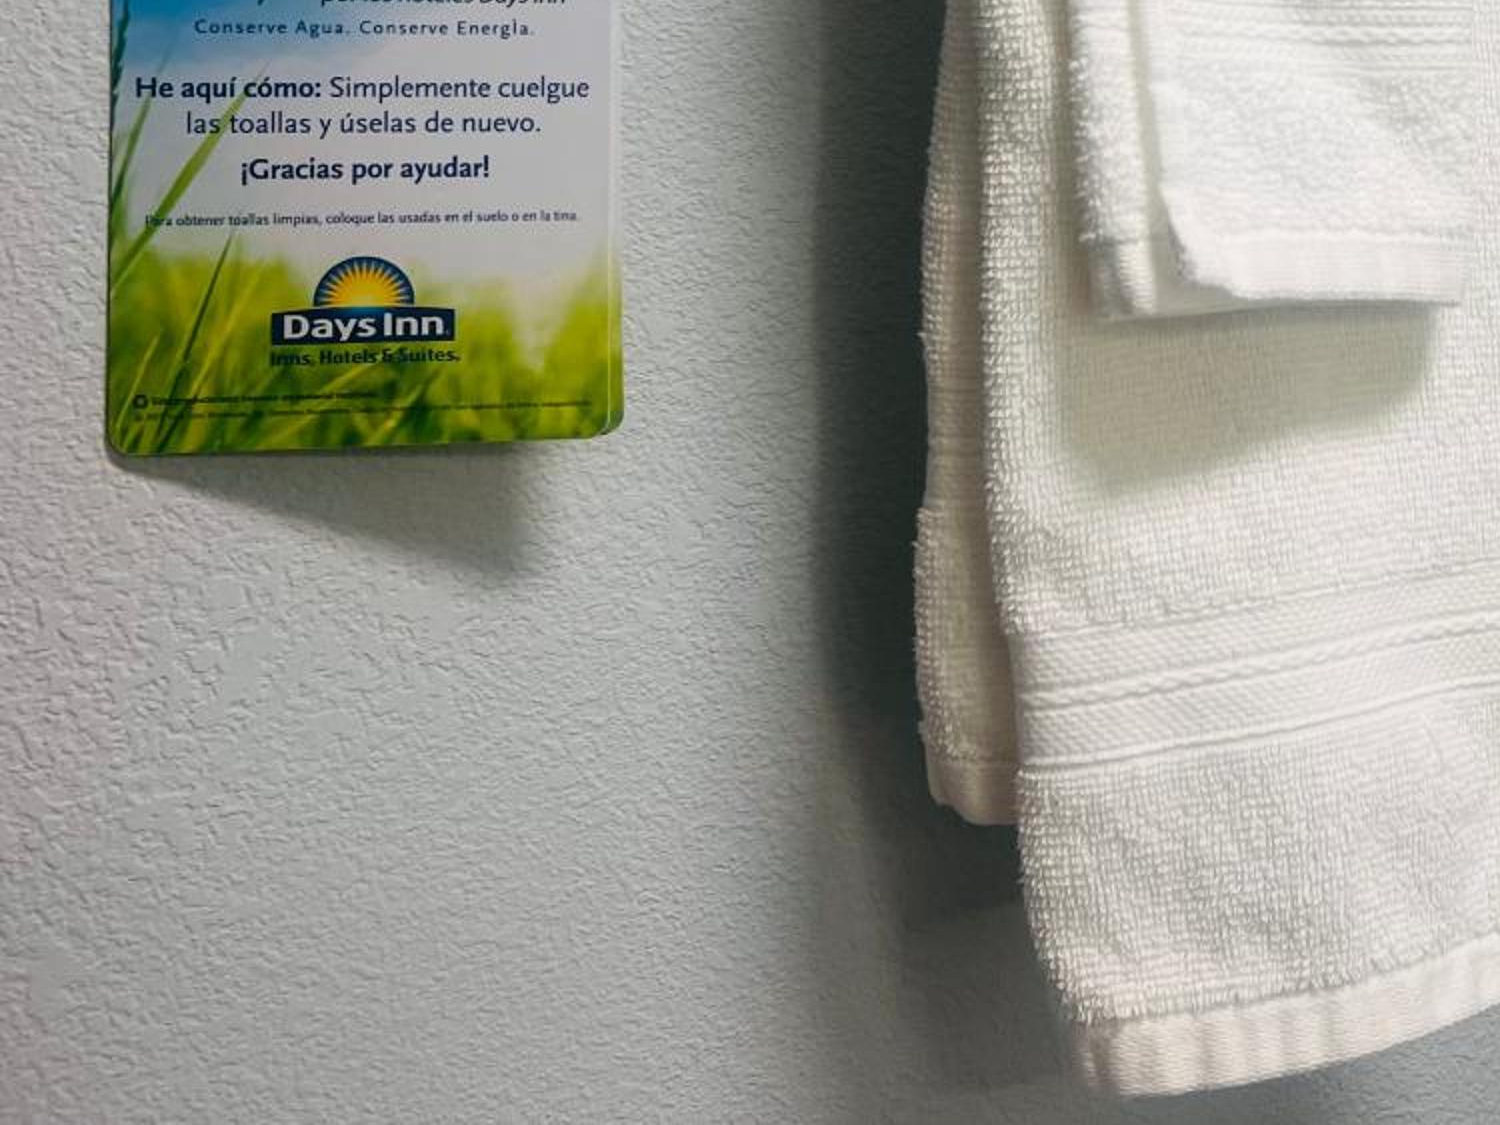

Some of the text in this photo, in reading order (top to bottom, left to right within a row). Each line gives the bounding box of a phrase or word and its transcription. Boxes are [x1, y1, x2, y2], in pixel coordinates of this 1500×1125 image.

[194, 19, 288, 35] Conserve
[359, 20, 449, 36] Conserve
[135, 75, 590, 104] He aquí cómo: Simplemente cuelgue
[186, 110, 541, 139] las toallas y úselas de nuevo.
[241, 155, 489, 186] ¡Gracias por ayudar!
[176, 213, 225, 226] obtener
[229, 212, 269, 226] toallas
[326, 212, 375, 225] coloque
[378, 211, 395, 224] las
[399, 210, 441, 224] usadas
[444, 212, 459, 223] en
[462, 210, 473, 223] el
[477, 210, 508, 223] suelo
[522, 211, 537, 222] en
[540, 210, 551, 221] la
[283, 312, 445, 342] Days Inn
[320, 349, 378, 365] Hotels
